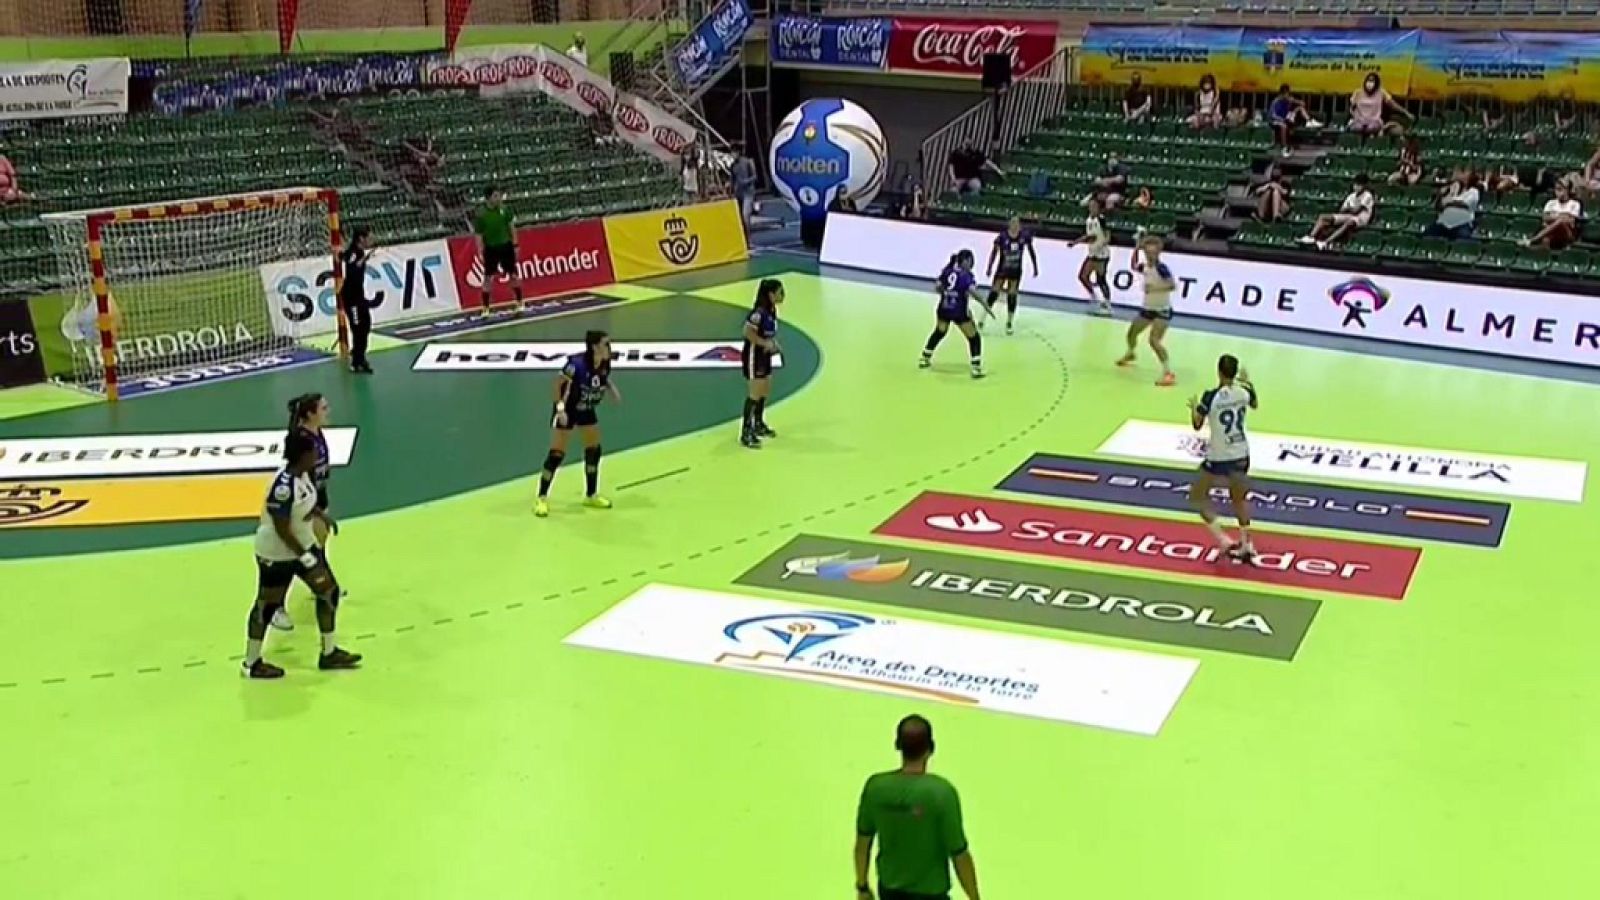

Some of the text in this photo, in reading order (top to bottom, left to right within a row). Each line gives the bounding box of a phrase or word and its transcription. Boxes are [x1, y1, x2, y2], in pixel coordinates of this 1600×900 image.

[913, 23, 1027, 67] Coca-Cola
[777, 155, 840, 174] molten
[947, 272, 957, 290] 9
[18, 442, 280, 464] IBERDROL
[1277, 449, 1510, 484] MELILLA
[911, 569, 1274, 636] IBERDROLA
[816, 649, 1040, 693] Area de Deportes
